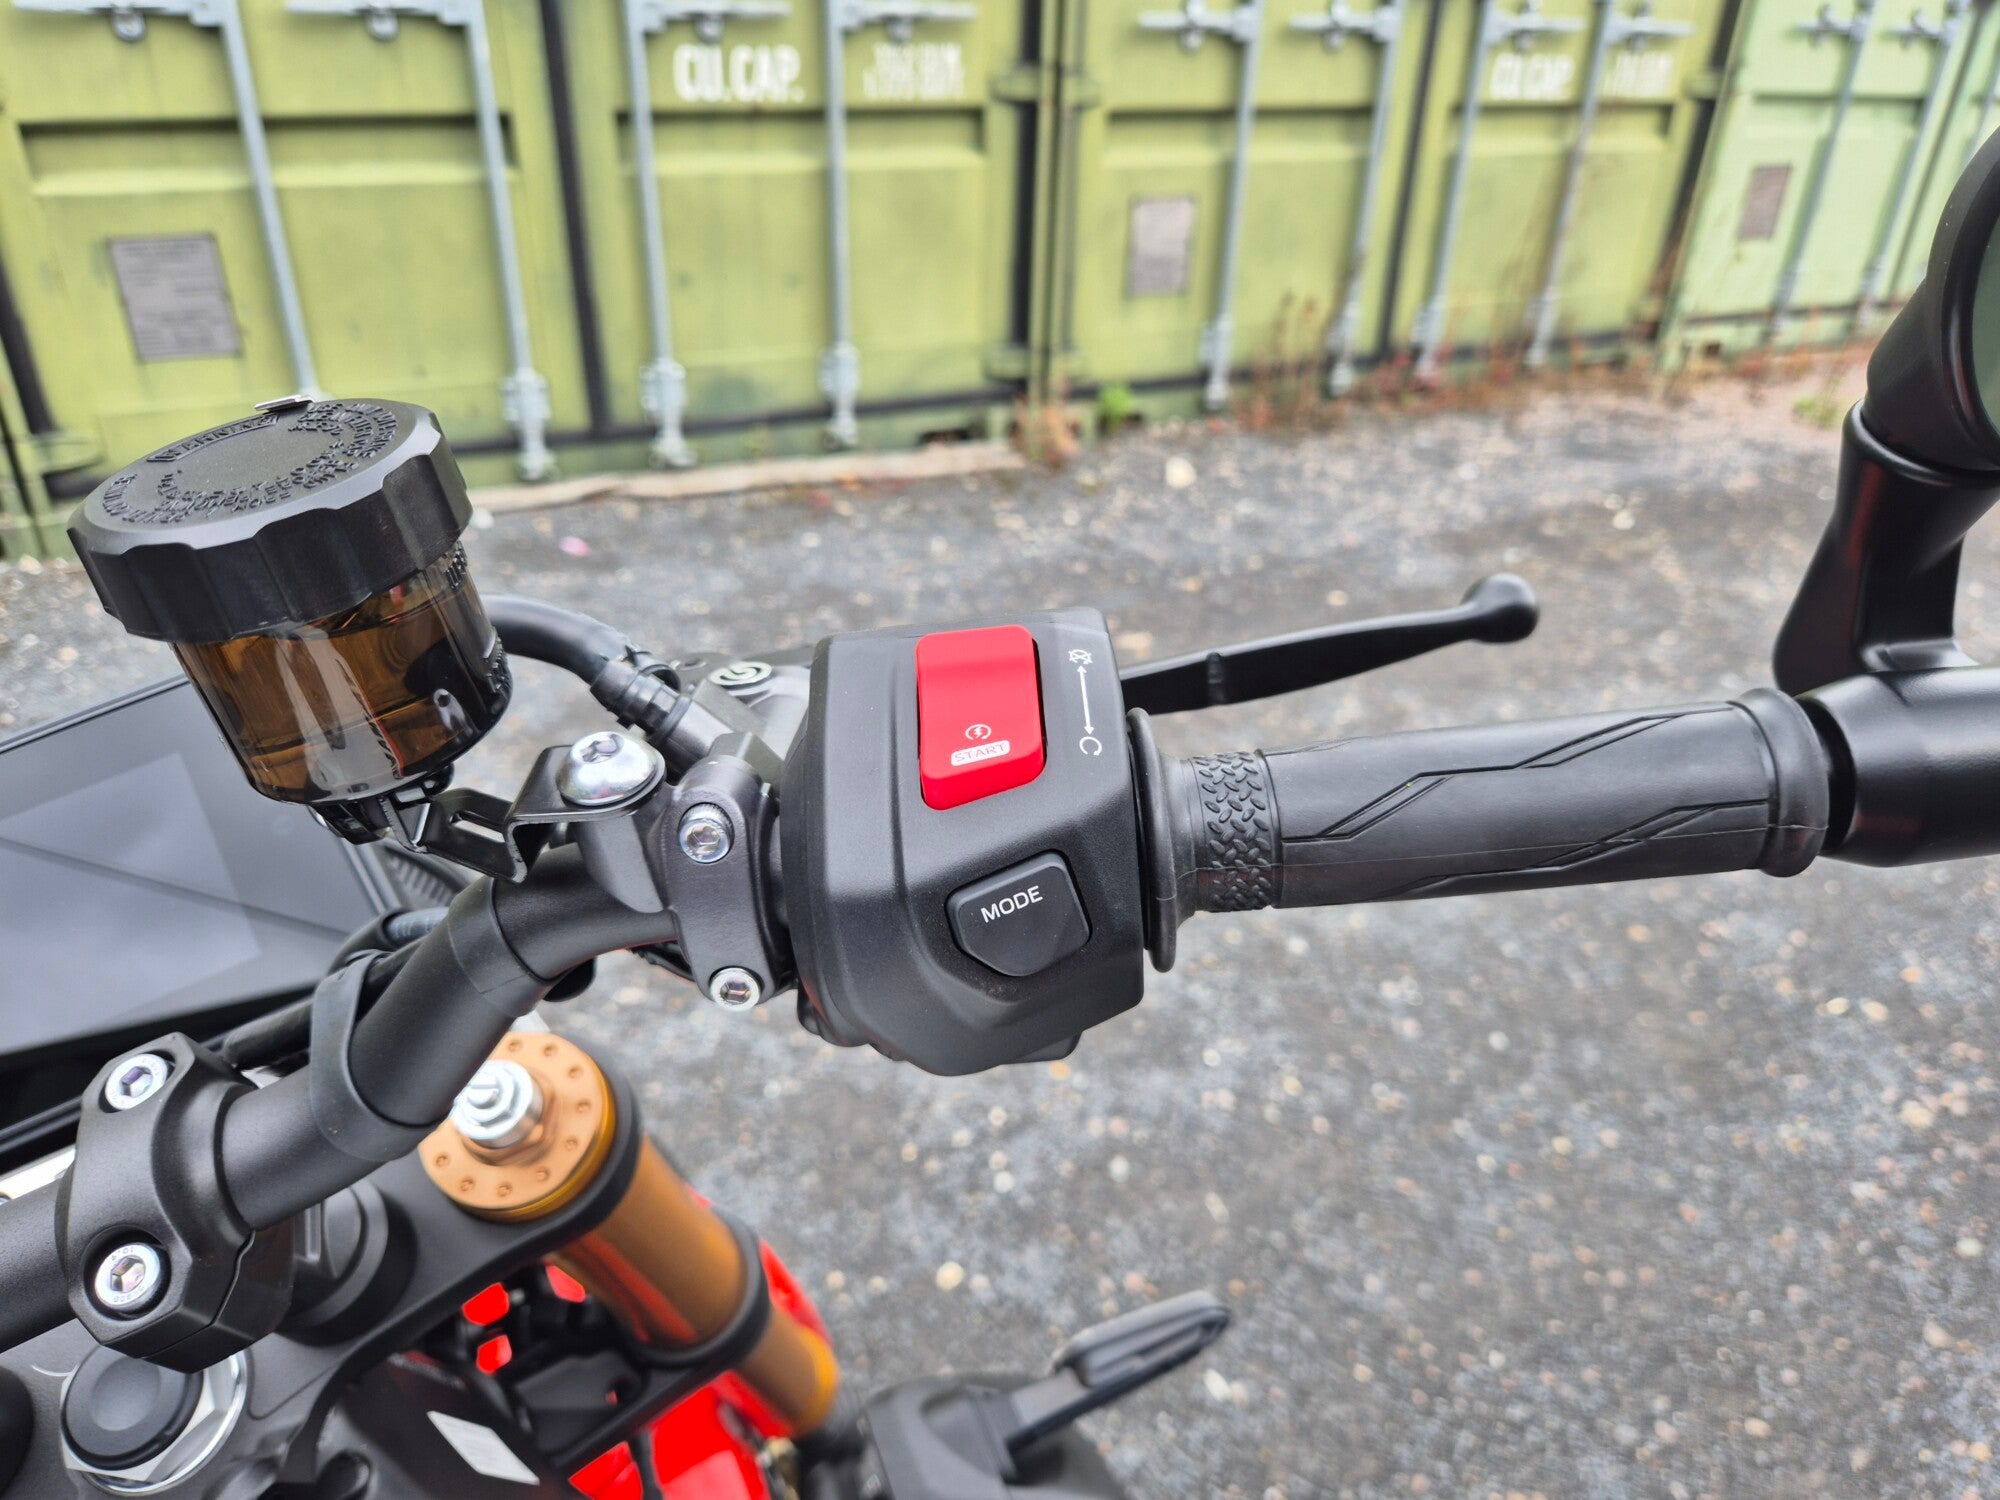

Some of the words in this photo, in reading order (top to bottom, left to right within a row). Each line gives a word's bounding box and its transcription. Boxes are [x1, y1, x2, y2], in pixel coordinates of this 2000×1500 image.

[155, 414, 276, 459] WARNING
[954, 742, 1006, 763] START
[980, 885, 1044, 924] MODE
